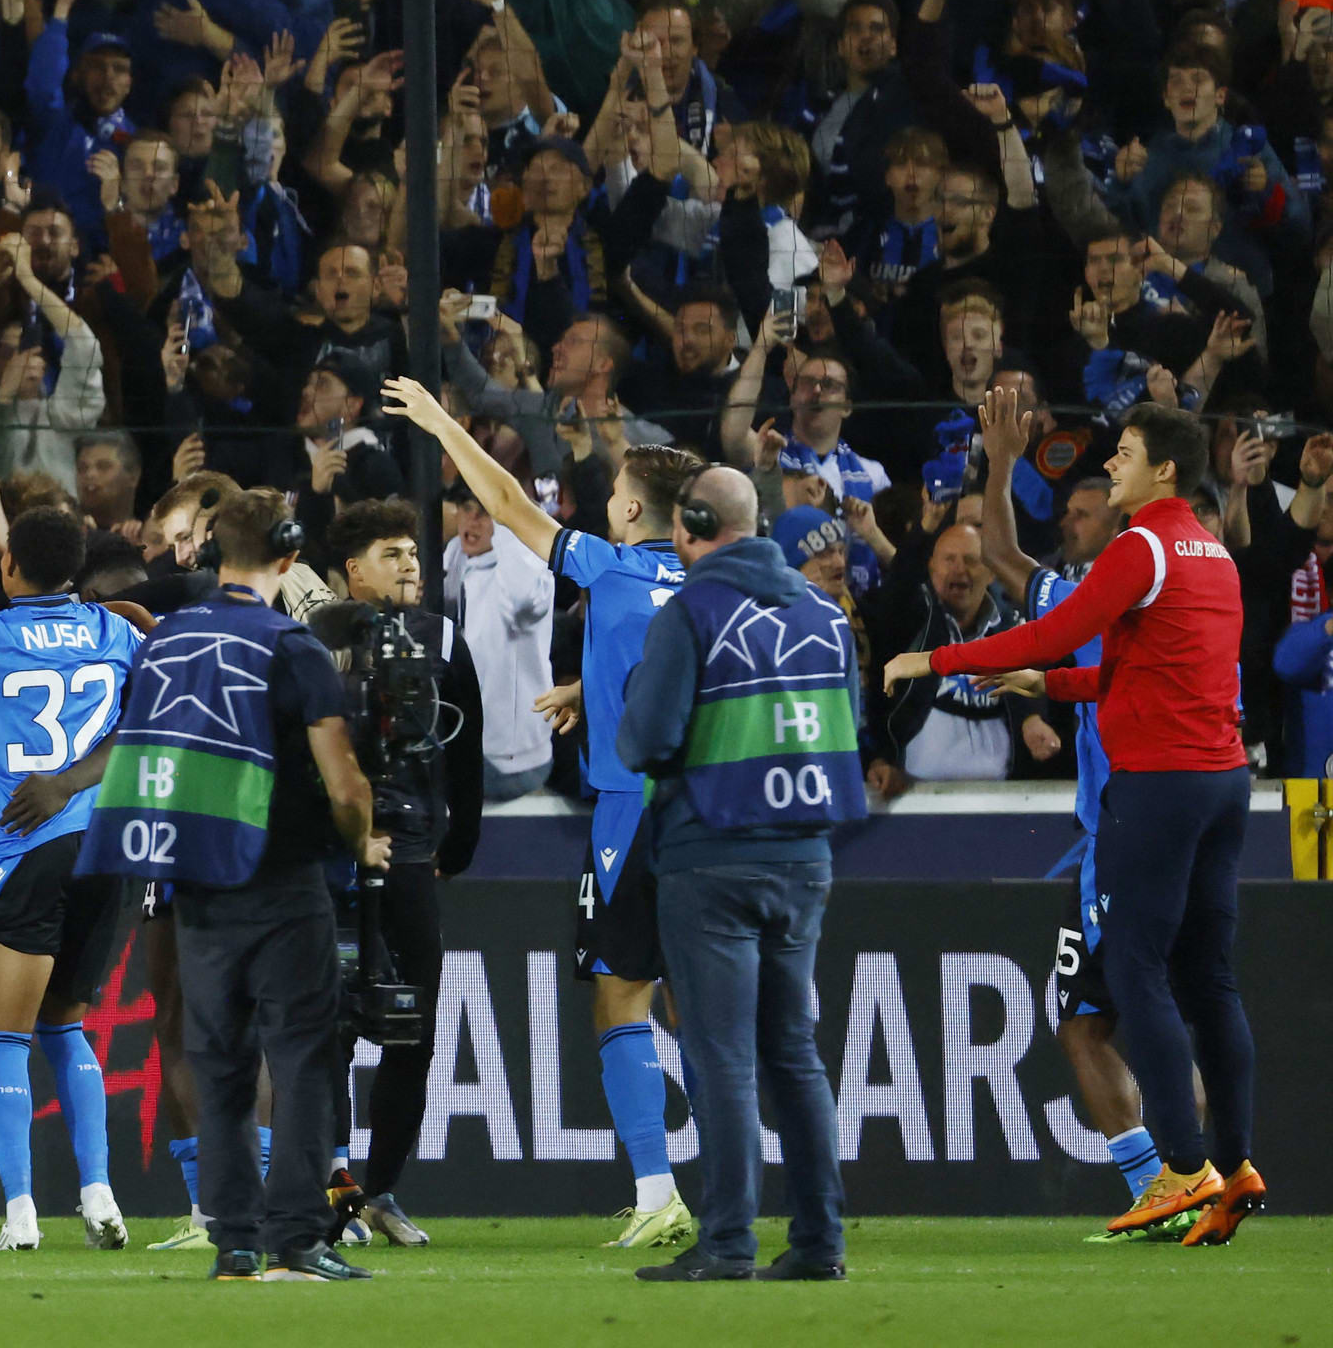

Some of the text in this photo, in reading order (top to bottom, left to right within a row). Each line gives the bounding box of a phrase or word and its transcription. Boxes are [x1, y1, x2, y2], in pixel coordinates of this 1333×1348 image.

[1175, 539, 1203, 557] CLUB
[21, 624, 96, 650] NUSA
[2, 663, 117, 773] 32
[774, 702, 821, 744] HB
[139, 755, 175, 799] HB
